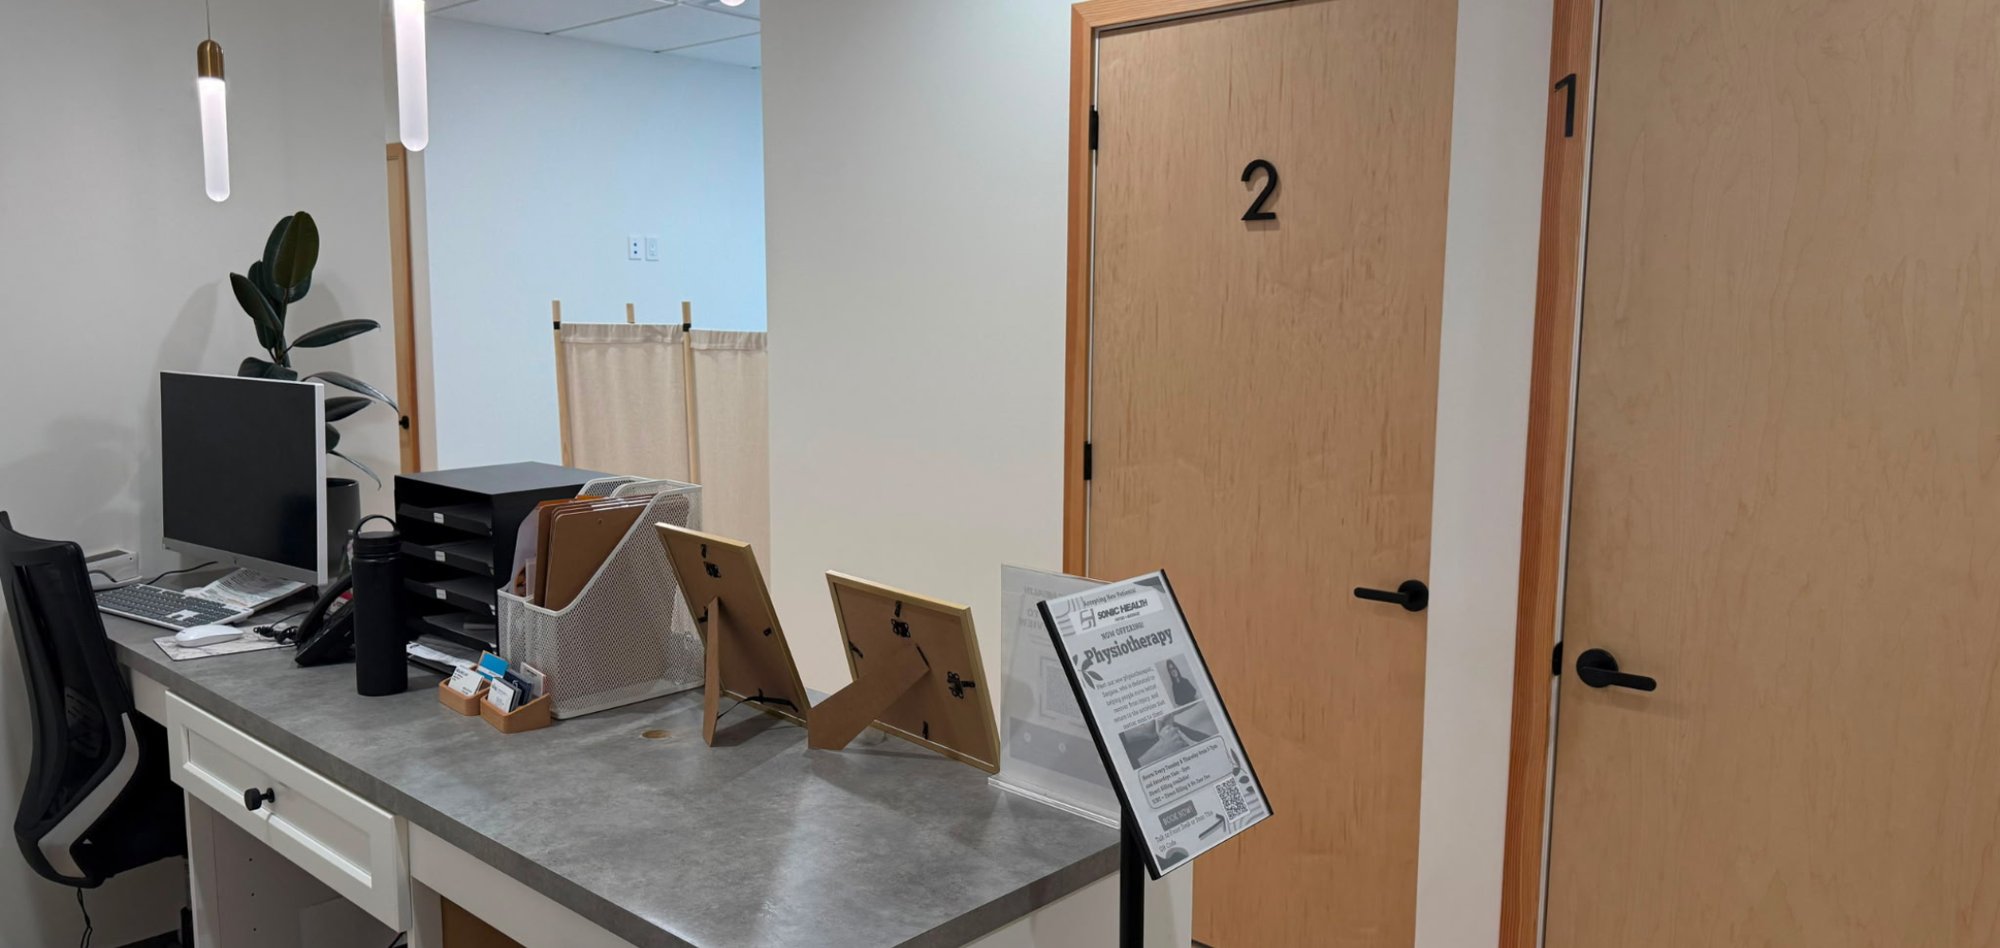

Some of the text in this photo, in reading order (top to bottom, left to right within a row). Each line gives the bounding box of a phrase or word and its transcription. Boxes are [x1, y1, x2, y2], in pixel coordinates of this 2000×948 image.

[1554, 73, 1577, 138] 1
[1240, 159, 1280, 221] 2
[1097, 606, 1121, 620] SONIC
[1120, 598, 1148, 612] HEALTH
[1084, 628, 1173, 664] Physiotherapy
[1100, 630, 1117, 640] NOW
